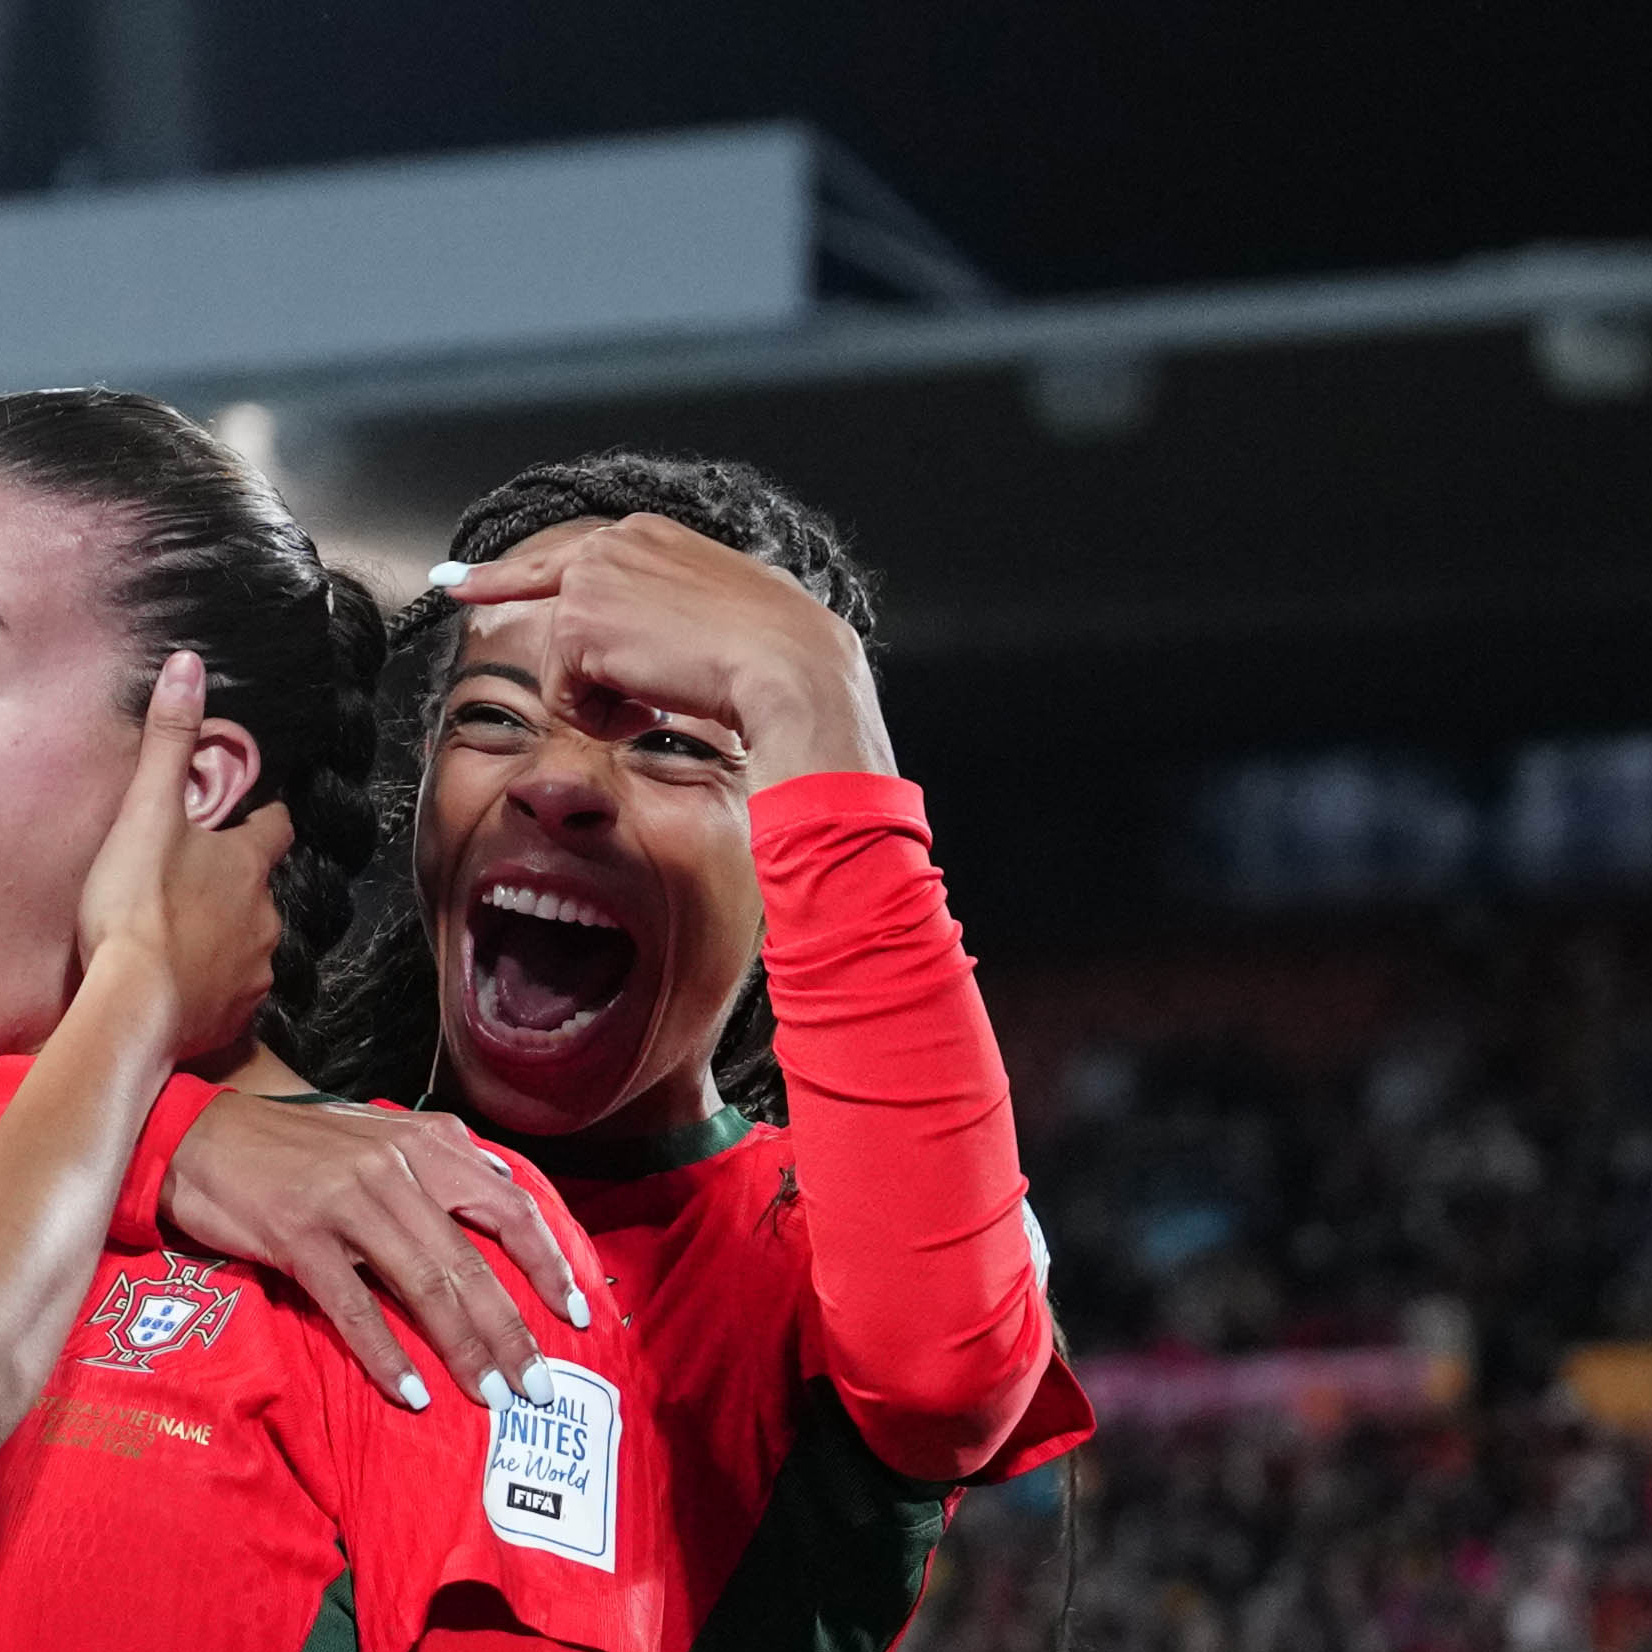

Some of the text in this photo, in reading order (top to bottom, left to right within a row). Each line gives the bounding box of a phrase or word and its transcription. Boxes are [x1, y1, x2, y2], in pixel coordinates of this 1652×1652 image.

[118, 1407, 213, 1446] VIETNAME
[492, 1442, 590, 1496] he World
[513, 1487, 556, 1515] FIFA
